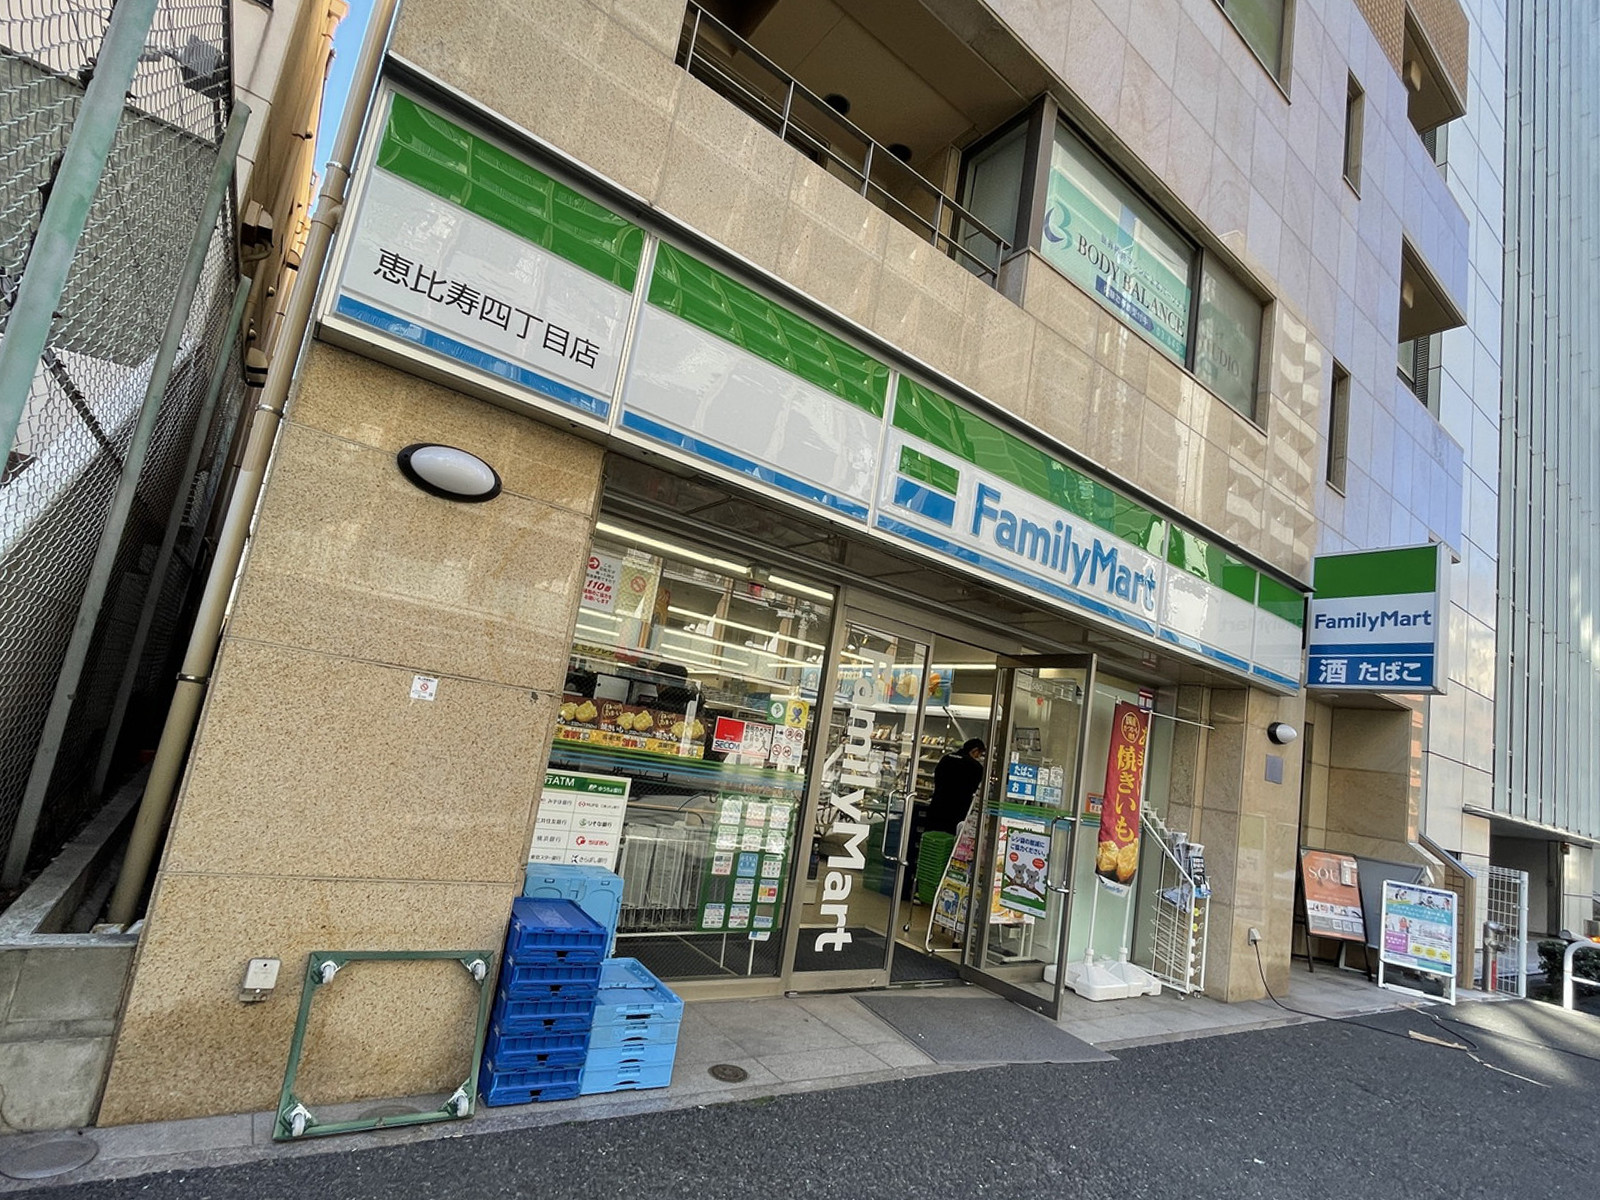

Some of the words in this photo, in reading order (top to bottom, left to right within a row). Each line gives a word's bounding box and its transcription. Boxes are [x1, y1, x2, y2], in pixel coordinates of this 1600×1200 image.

[373, 248, 600, 370] 恵比寿四丁目店
[1077, 233, 1120, 282] BODY
[1122, 271, 1186, 338] BALANCE
[969, 482, 1158, 613] FamilyMart
[1314, 609, 1432, 632] FamilyMart
[1318, 659, 1348, 684] 酒
[1358, 661, 1422, 682] たばこ
[714, 739, 740, 751] SECOM
[1013, 764, 1034, 778] たばこ
[813, 645, 894, 952] FamilyMart
[1115, 744, 1137, 843] 焼きいも
[1308, 865, 1341, 884] SOU
